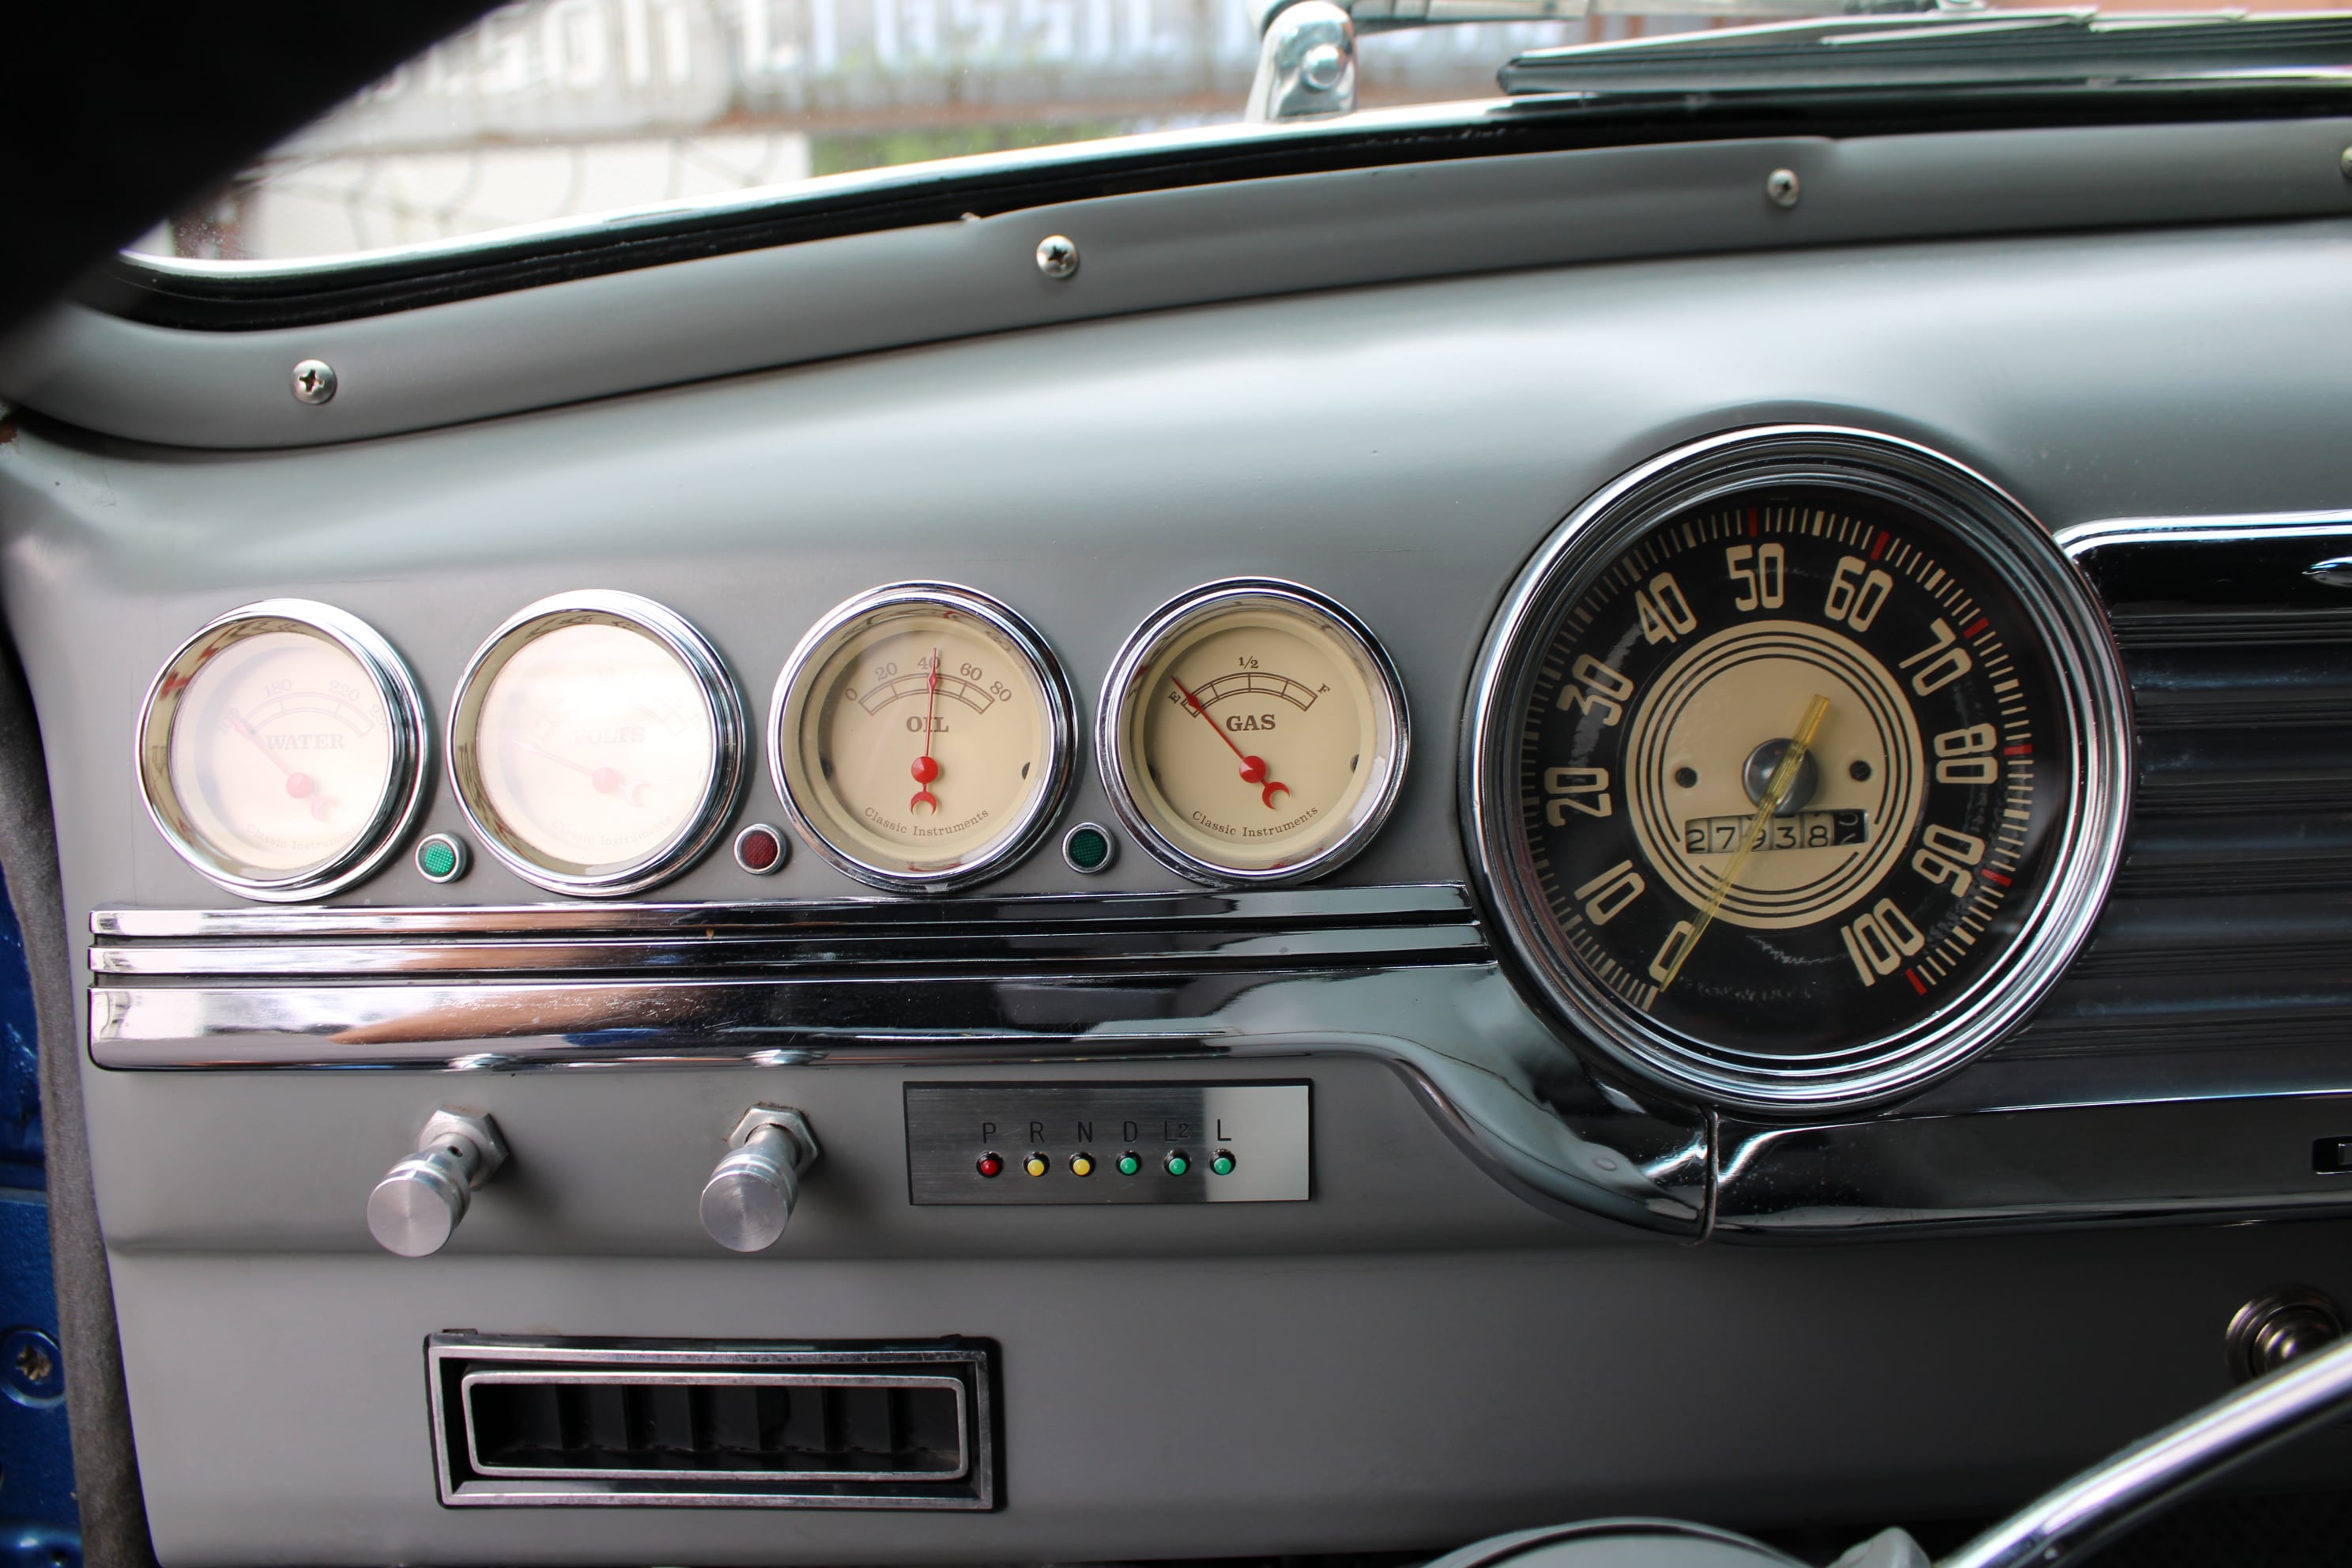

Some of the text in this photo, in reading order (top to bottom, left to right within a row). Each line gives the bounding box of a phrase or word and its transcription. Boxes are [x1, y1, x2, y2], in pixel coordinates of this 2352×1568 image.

[1726, 543, 1785, 611] 50
[1824, 556, 1894, 632] 60
[1635, 572, 1698, 645] 40
[845, 657, 1012, 702] 0 20 40 60 80
[1167, 656, 1331, 704] E 1/2 F
[1899, 618, 1973, 696] 70
[263, 679, 293, 698] 180
[329, 680, 361, 703] 220
[1557, 654, 1634, 727] 30
[266, 733, 345, 750] WATER
[574, 726, 646, 744] VOLTS
[906, 716, 948, 733] OIL
[1226, 714, 1276, 732] GAS
[1934, 722, 1997, 784] 80
[865, 806, 989, 837] Classic Instruments
[1192, 806, 1318, 838] Classic Instruments
[1544, 767, 1612, 827] 20
[1911, 824, 1984, 897] 90
[1574, 860, 1645, 925] 10
[1649, 920, 1695, 982] 0
[1841, 898, 1925, 987] 100
[982, 1121, 997, 1144] P
[1030, 1121, 1045, 1144] R
[1077, 1121, 1094, 1144] N
[1123, 1120, 1138, 1143] D
[1217, 1118, 1232, 1142] L
